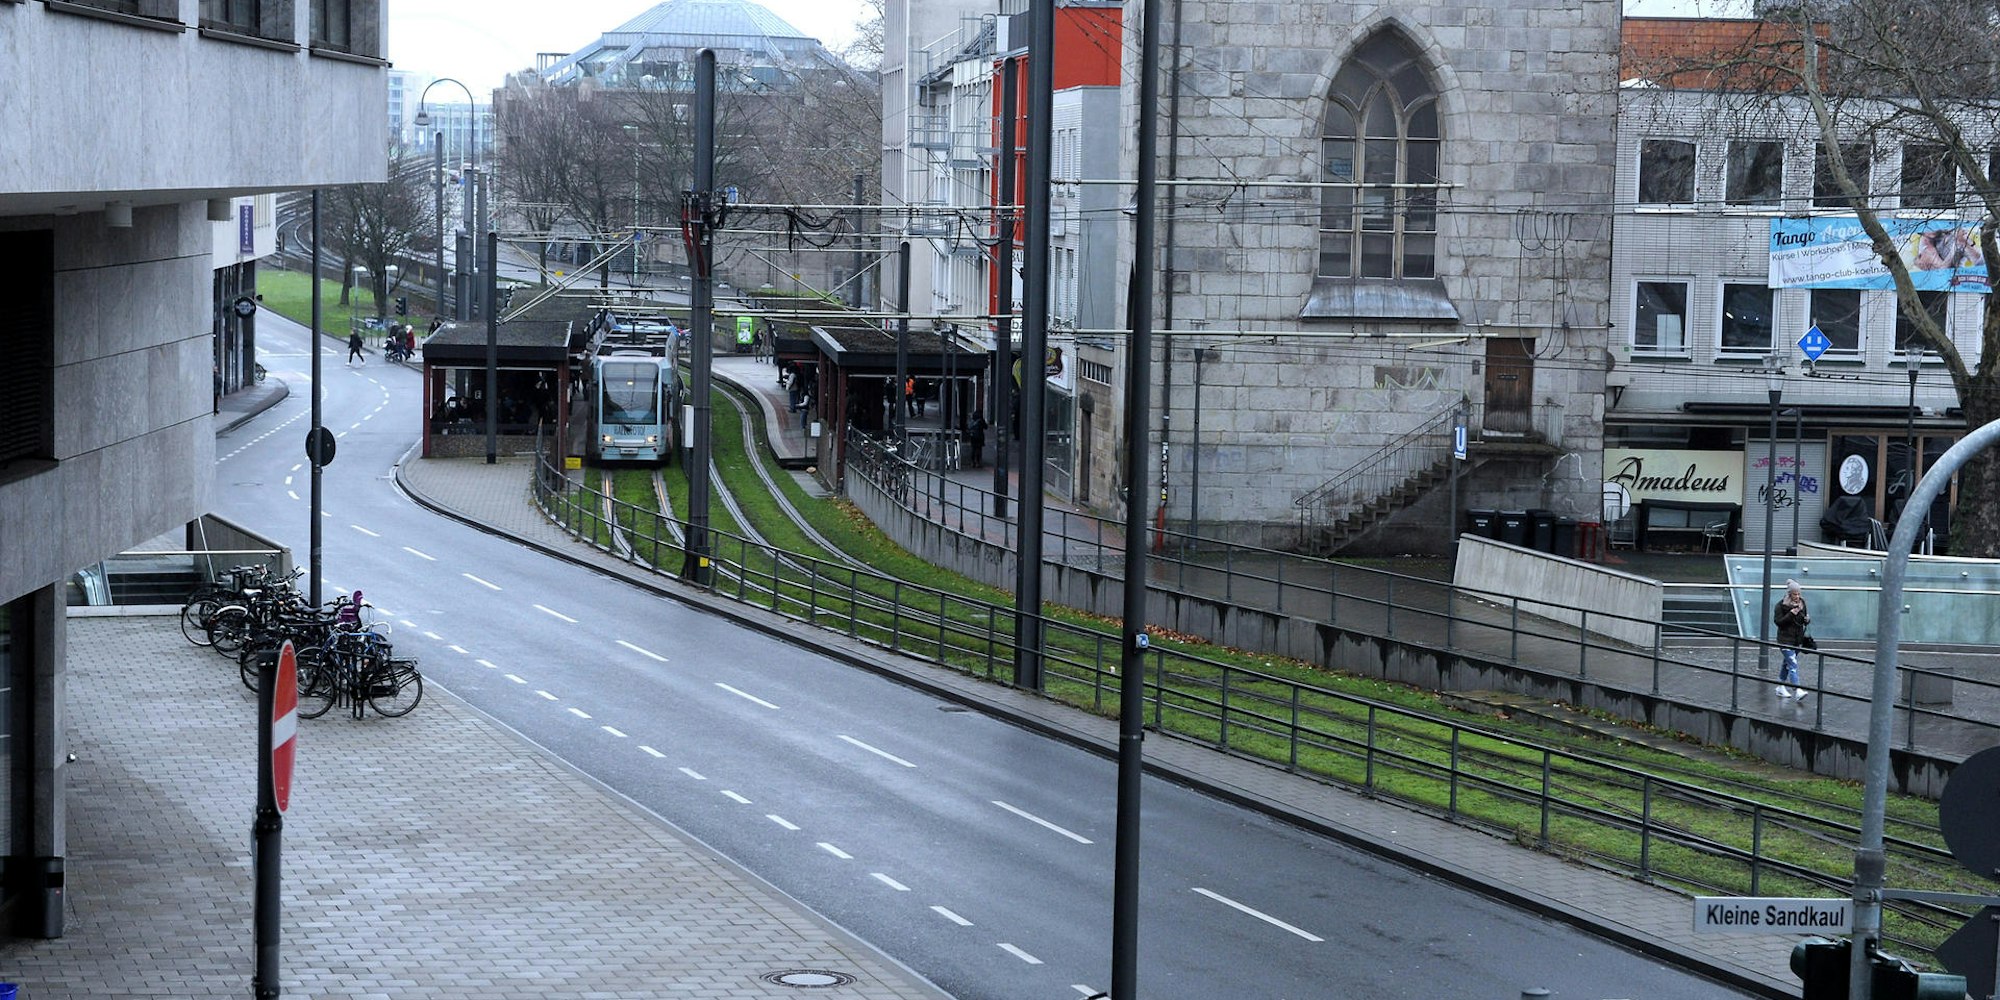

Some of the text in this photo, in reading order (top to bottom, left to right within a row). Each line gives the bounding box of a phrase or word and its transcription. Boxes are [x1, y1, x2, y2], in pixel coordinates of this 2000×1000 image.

[1773, 231, 1815, 247] Tango
[1772, 253, 1796, 261] Kurse
[1801, 244, 1847, 258] Workshops
[1608, 456, 1730, 491] Amadeus
[1706, 904, 1844, 927] Kleine Sandkaul
